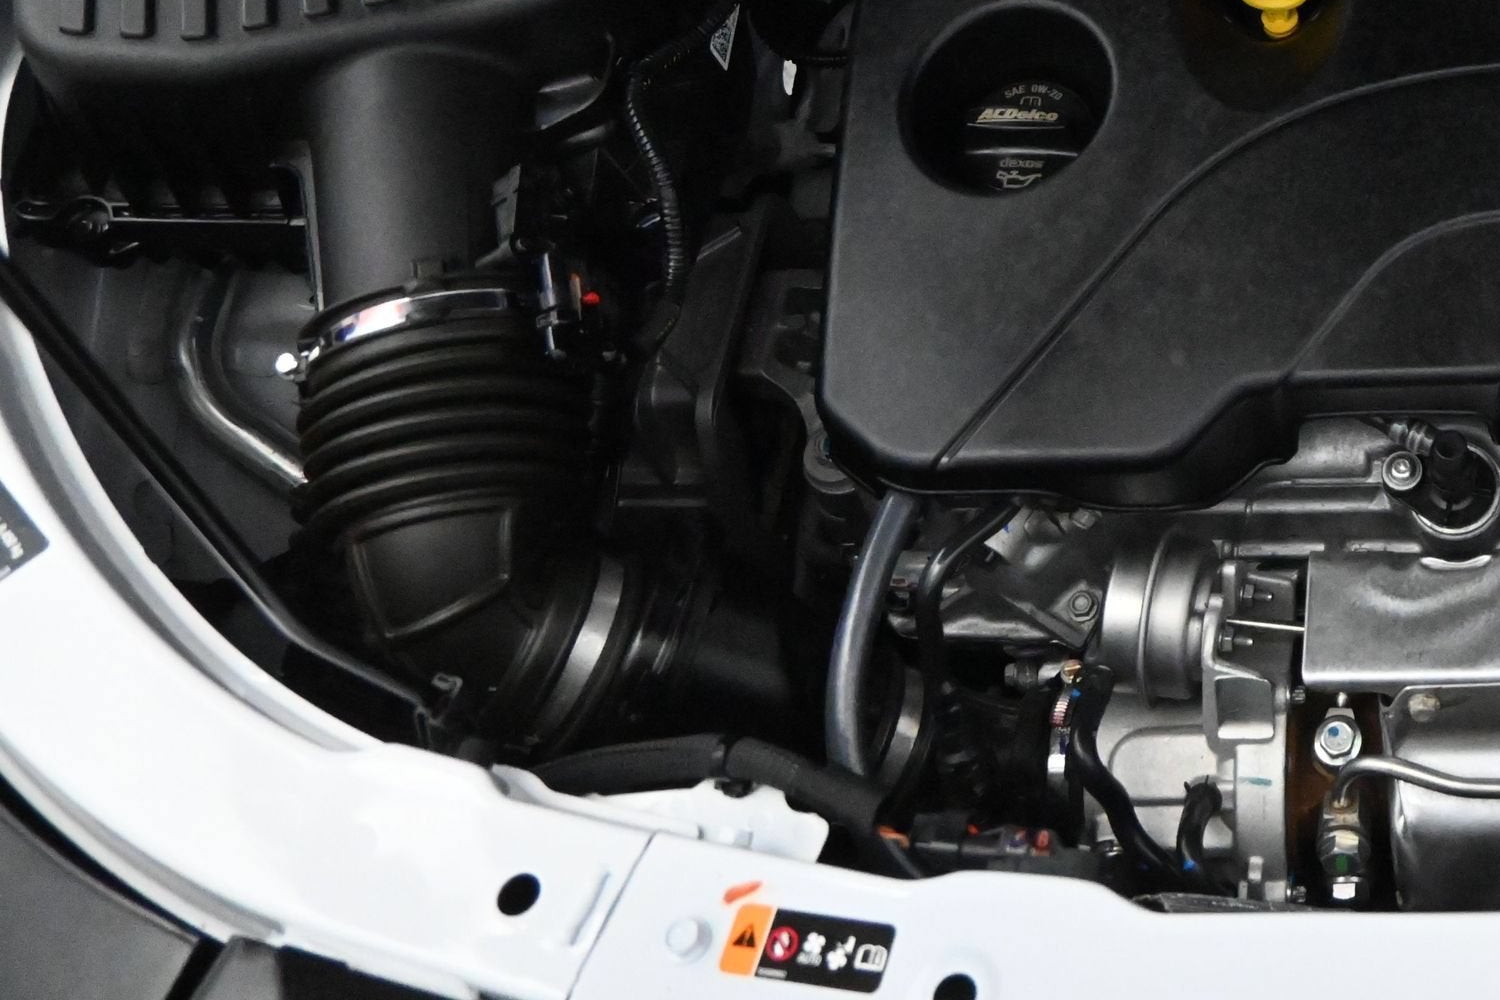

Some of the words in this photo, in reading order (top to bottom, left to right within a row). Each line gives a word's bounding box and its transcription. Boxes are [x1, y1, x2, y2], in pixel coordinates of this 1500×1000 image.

[1003, 84, 1026, 98] SAE
[1031, 84, 1064, 101] 0W-20
[977, 107, 1059, 122] ACDelco
